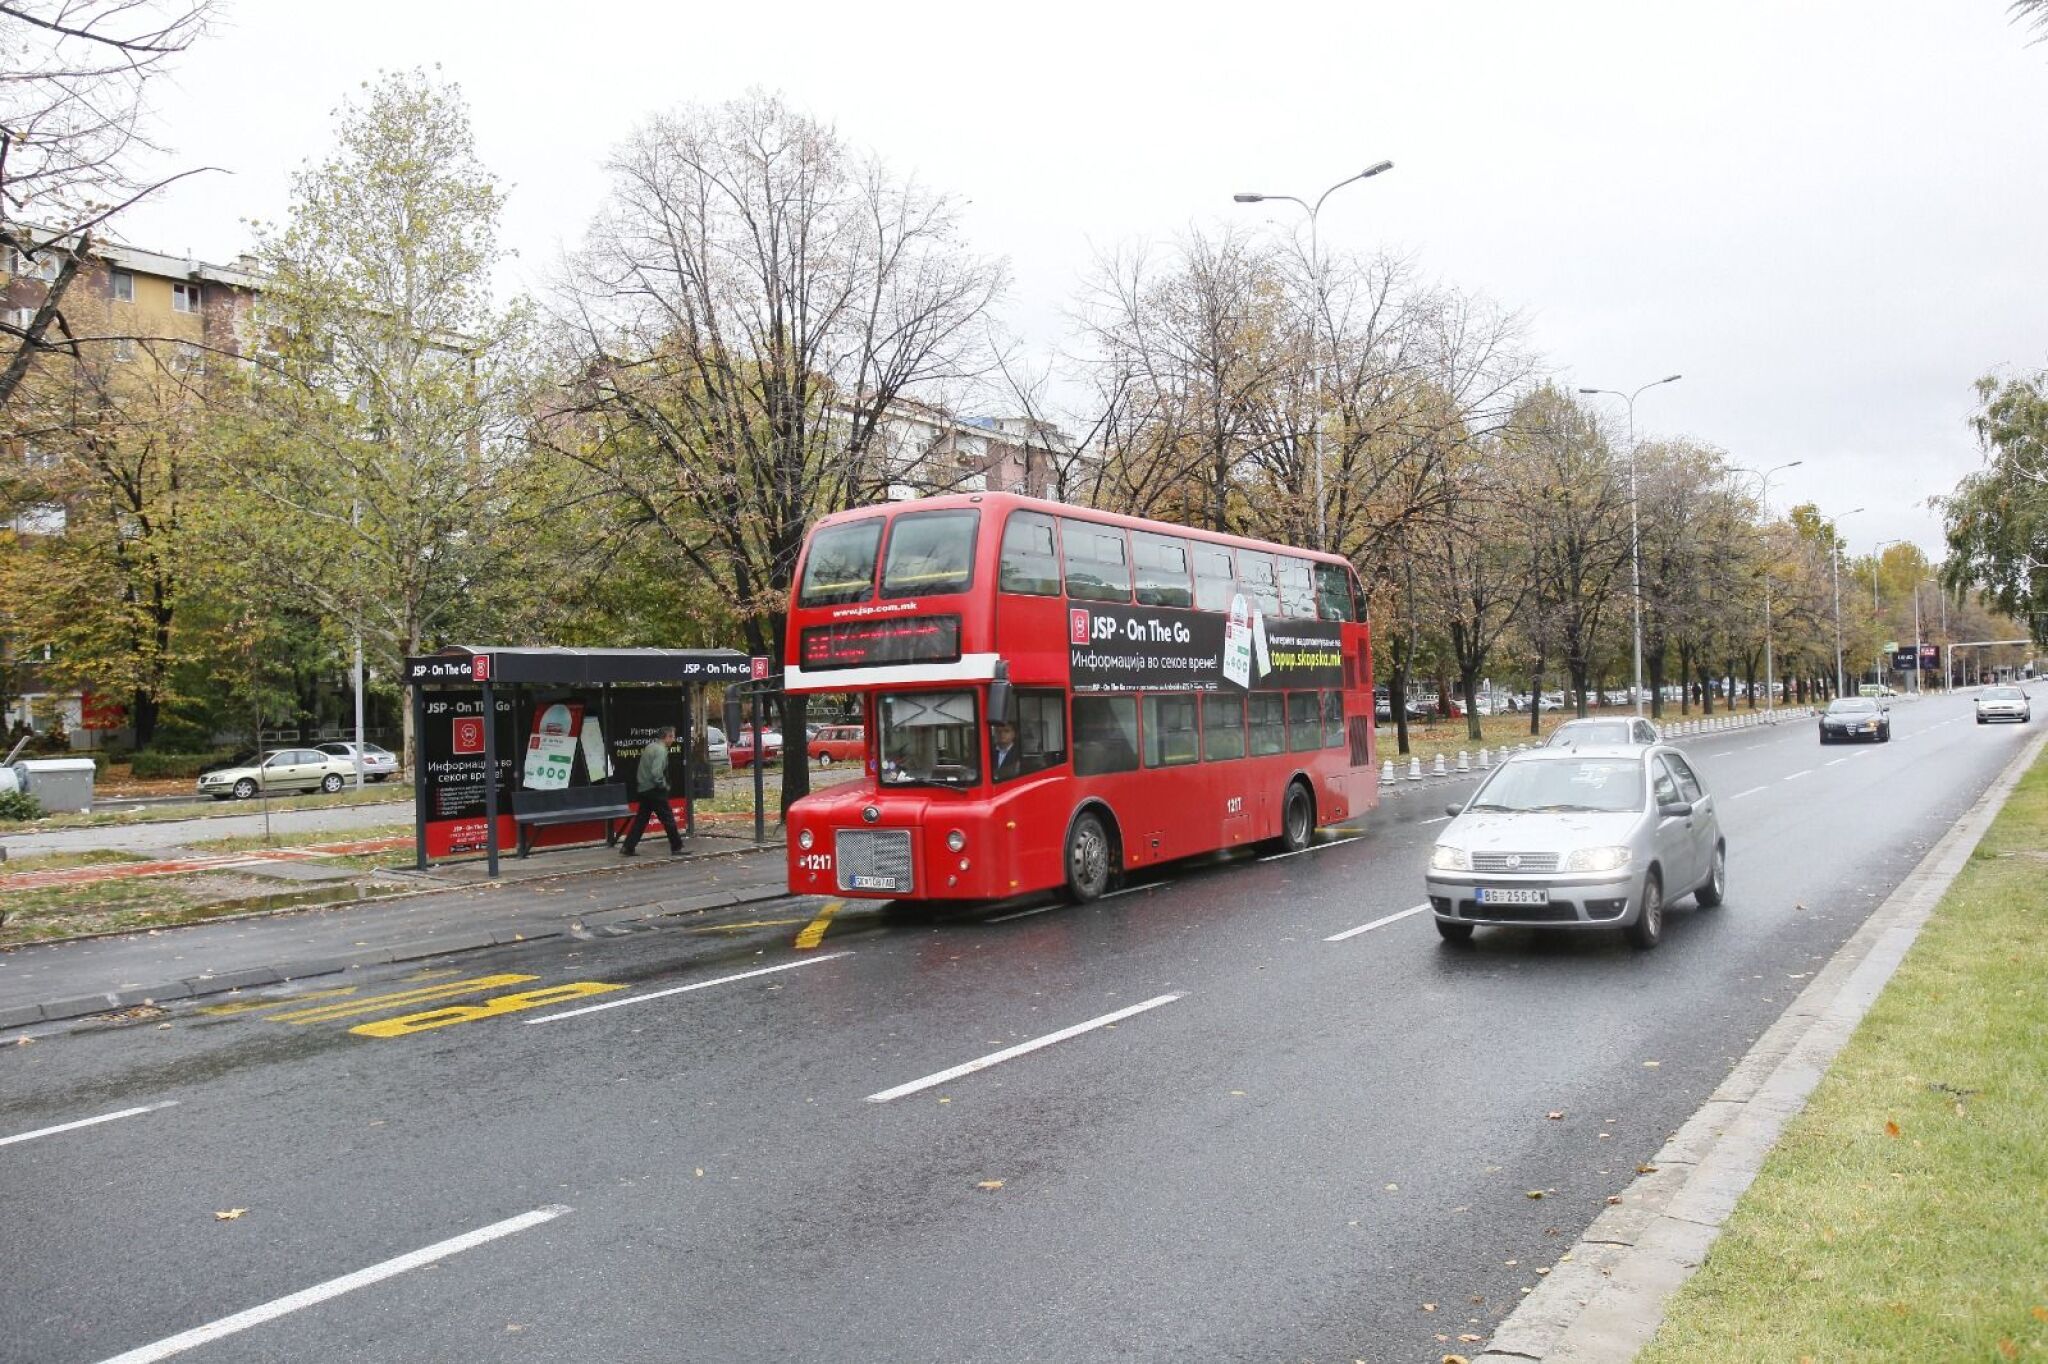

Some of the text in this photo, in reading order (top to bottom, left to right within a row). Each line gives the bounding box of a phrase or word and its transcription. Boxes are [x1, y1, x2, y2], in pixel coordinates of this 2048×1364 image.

[832, 601, 918, 618] www.jsp.com.mk
[1091, 616, 1117, 640] JSP
[1127, 618, 1147, 641] On
[1148, 619, 1173, 642] The
[1173, 621, 1190, 644] Go
[683, 663, 700, 674] JSP
[706, 663, 720, 674] On
[721, 662, 737, 674] The
[738, 663, 751, 674] Go
[1071, 649, 1218, 673] Информација во секое време!
[1270, 649, 1342, 672] topup.skopska.mk
[412, 664, 427, 677] JSP
[432, 664, 444, 676] On
[444, 663, 459, 676] The
[460, 663, 472, 675] Go
[427, 702, 448, 714] JSP
[456, 701, 472, 713] On
[495, 701, 510, 711] Go
[501, 759, 513, 768] во
[438, 773, 468, 783] секое
[1227, 797, 1242, 814] 1217
[807, 854, 832, 870] 1217
[1485, 890, 1498, 902] BG
